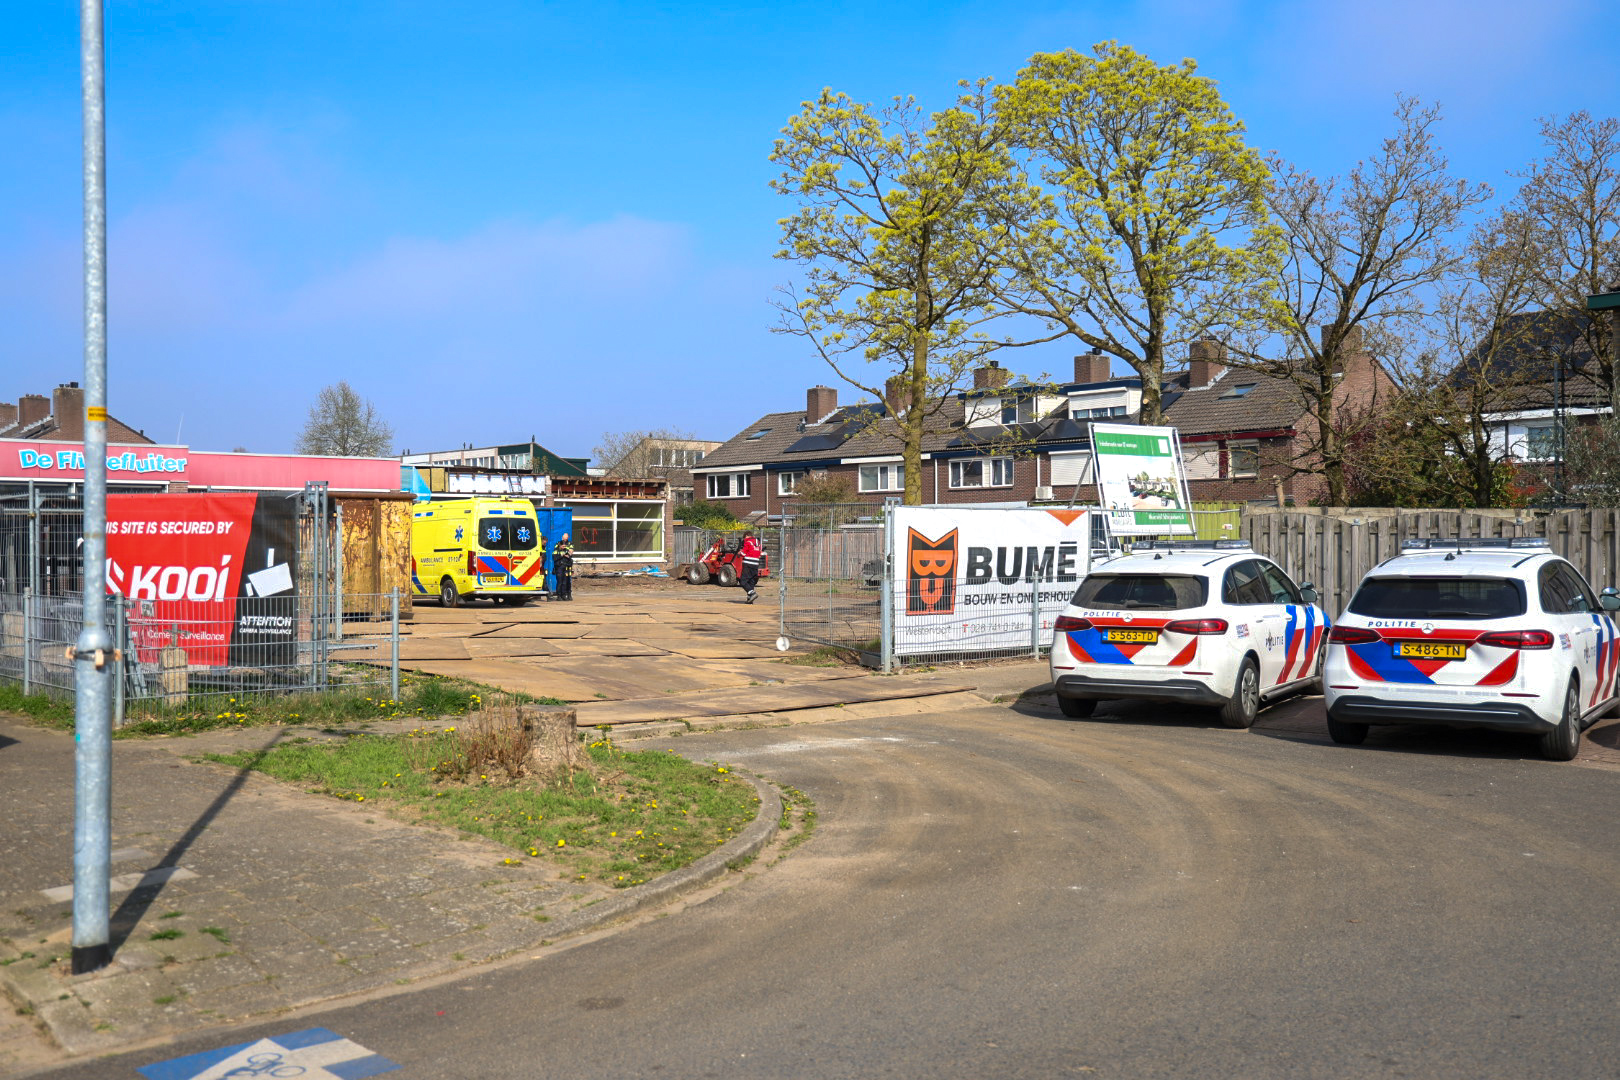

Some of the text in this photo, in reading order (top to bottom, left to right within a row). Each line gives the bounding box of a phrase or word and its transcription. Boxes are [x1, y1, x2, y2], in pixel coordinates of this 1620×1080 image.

[18, 449, 188, 474] De Fliefluiter
[121, 521, 146, 534] SITE
[146, 521, 158, 534] IS
[160, 521, 215, 534] SECURED
[216, 521, 234, 534] BY
[964, 590, 1077, 606] BOUW EN ONERHOUD
[240, 615, 292, 627] ATTENTION
[1368, 620, 1417, 628] POLITIE
[962, 623, 968, 633] T
[1110, 630, 1154, 641] S-563-TD
[1403, 643, 1460, 656] S-486-TN
